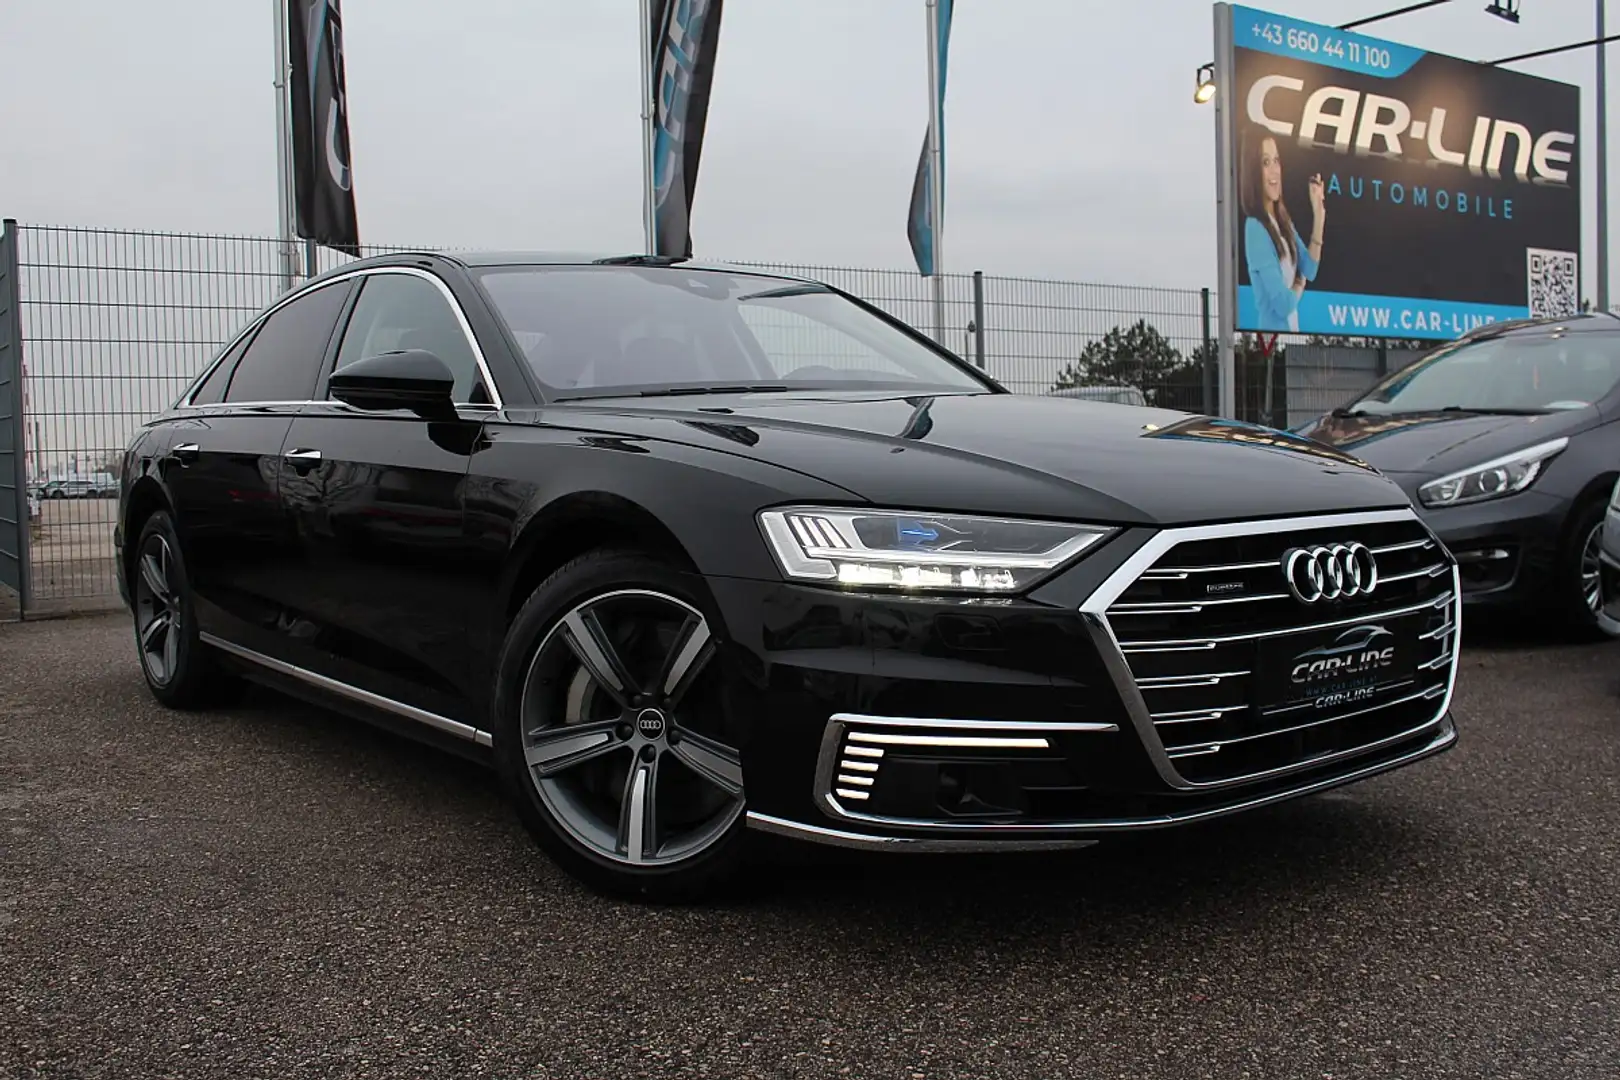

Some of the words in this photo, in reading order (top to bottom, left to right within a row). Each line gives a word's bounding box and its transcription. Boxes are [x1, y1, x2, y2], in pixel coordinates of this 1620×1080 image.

[1252, 23, 1283, 45] +43
[1287, 28, 1319, 53] 660
[1322, 36, 1345, 59] 44
[1348, 42, 1360, 63] 11
[1364, 45, 1391, 69] 100
[1246, 74, 1576, 181] CAR-LINE
[1328, 173, 1514, 220] AUTOMOBILE
[1328, 304, 1511, 333] WWW.CAR-LIN
[1291, 646, 1395, 683] CAR-LINE
